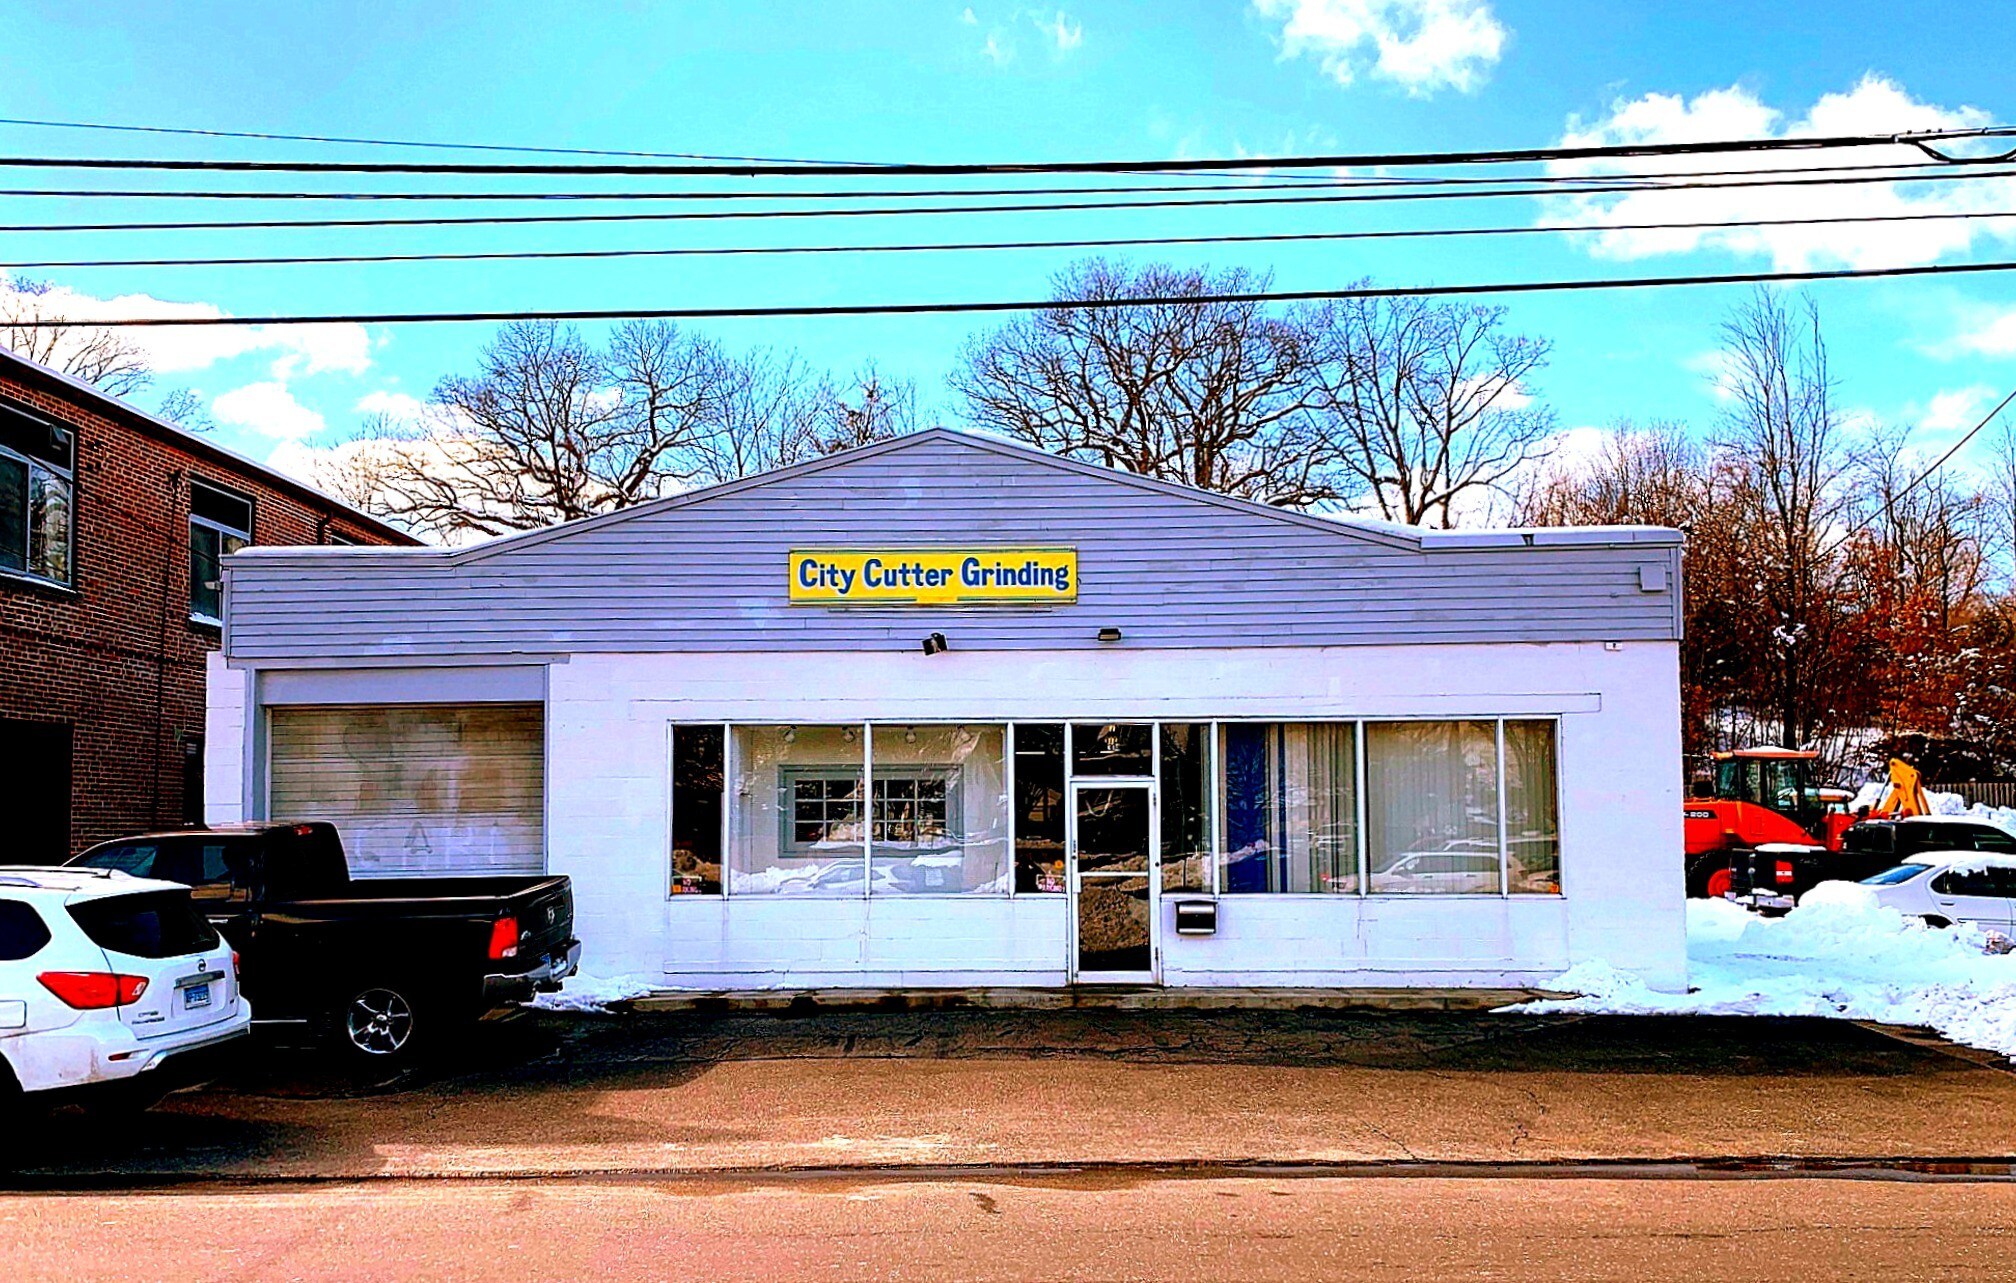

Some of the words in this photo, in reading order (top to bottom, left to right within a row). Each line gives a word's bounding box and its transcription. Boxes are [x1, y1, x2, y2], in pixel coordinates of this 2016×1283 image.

[799, 558, 856, 594] City
[864, 558, 953, 587] Cutter
[961, 557, 1070, 591] Grinding
